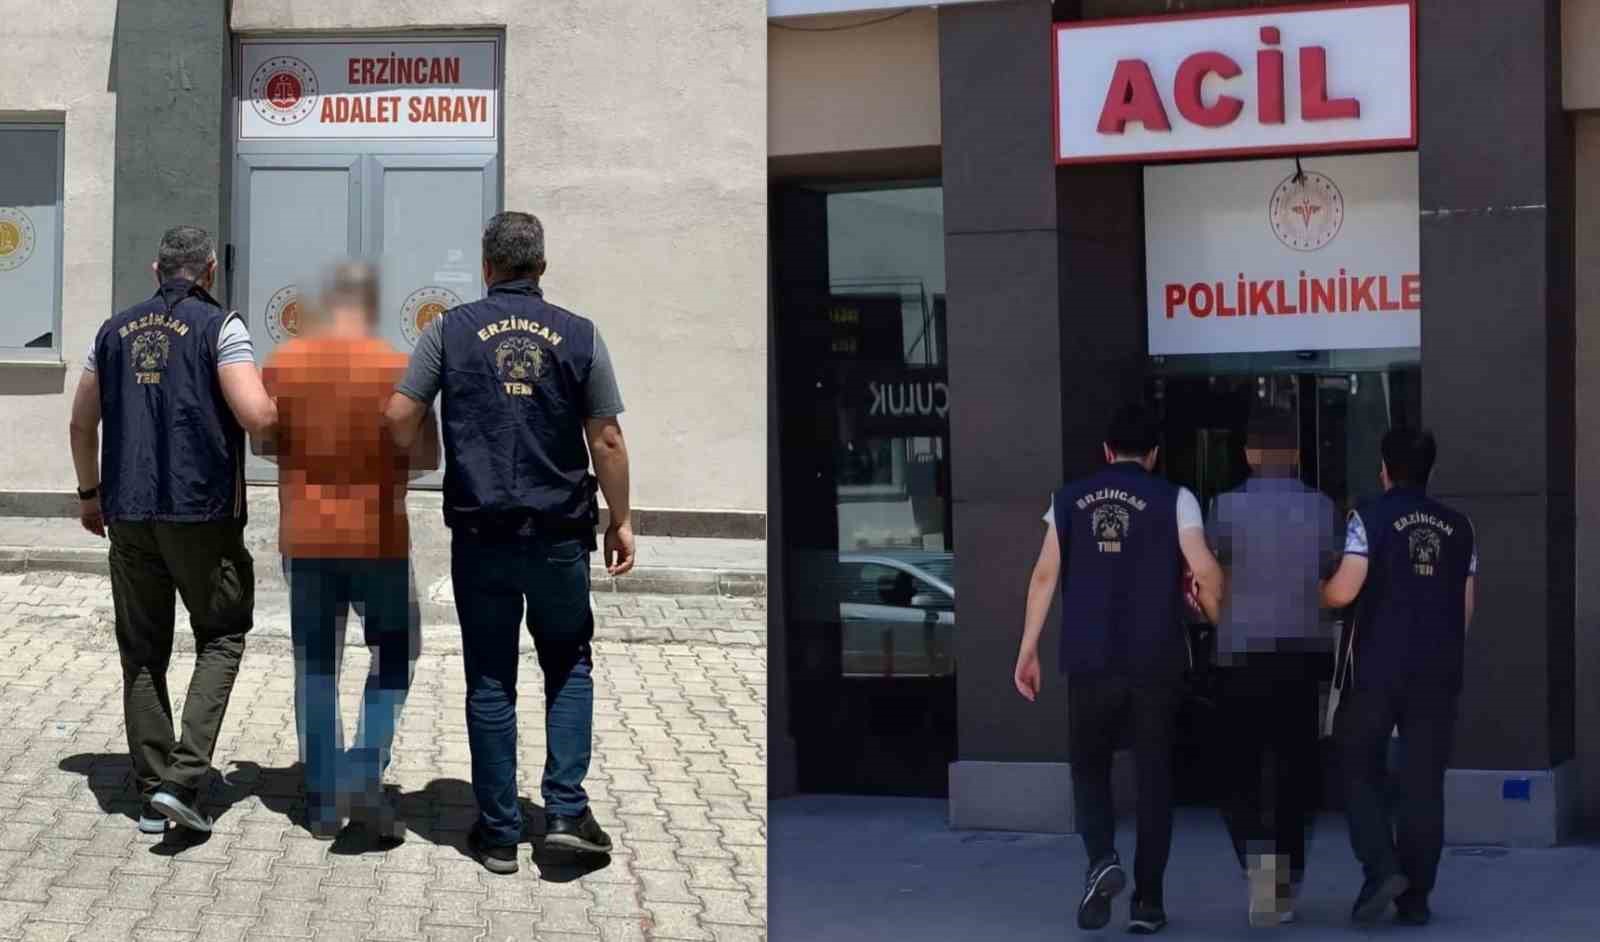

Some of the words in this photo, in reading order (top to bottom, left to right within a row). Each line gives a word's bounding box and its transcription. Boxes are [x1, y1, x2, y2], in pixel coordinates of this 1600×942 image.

[348, 52, 460, 84] ERZİNCAN
[1097, 26, 1361, 134] ACİL
[320, 96, 400, 123] ADALET
[408, 96, 488, 122] SARAYI
[477, 315, 562, 346] ERZİNCAN
